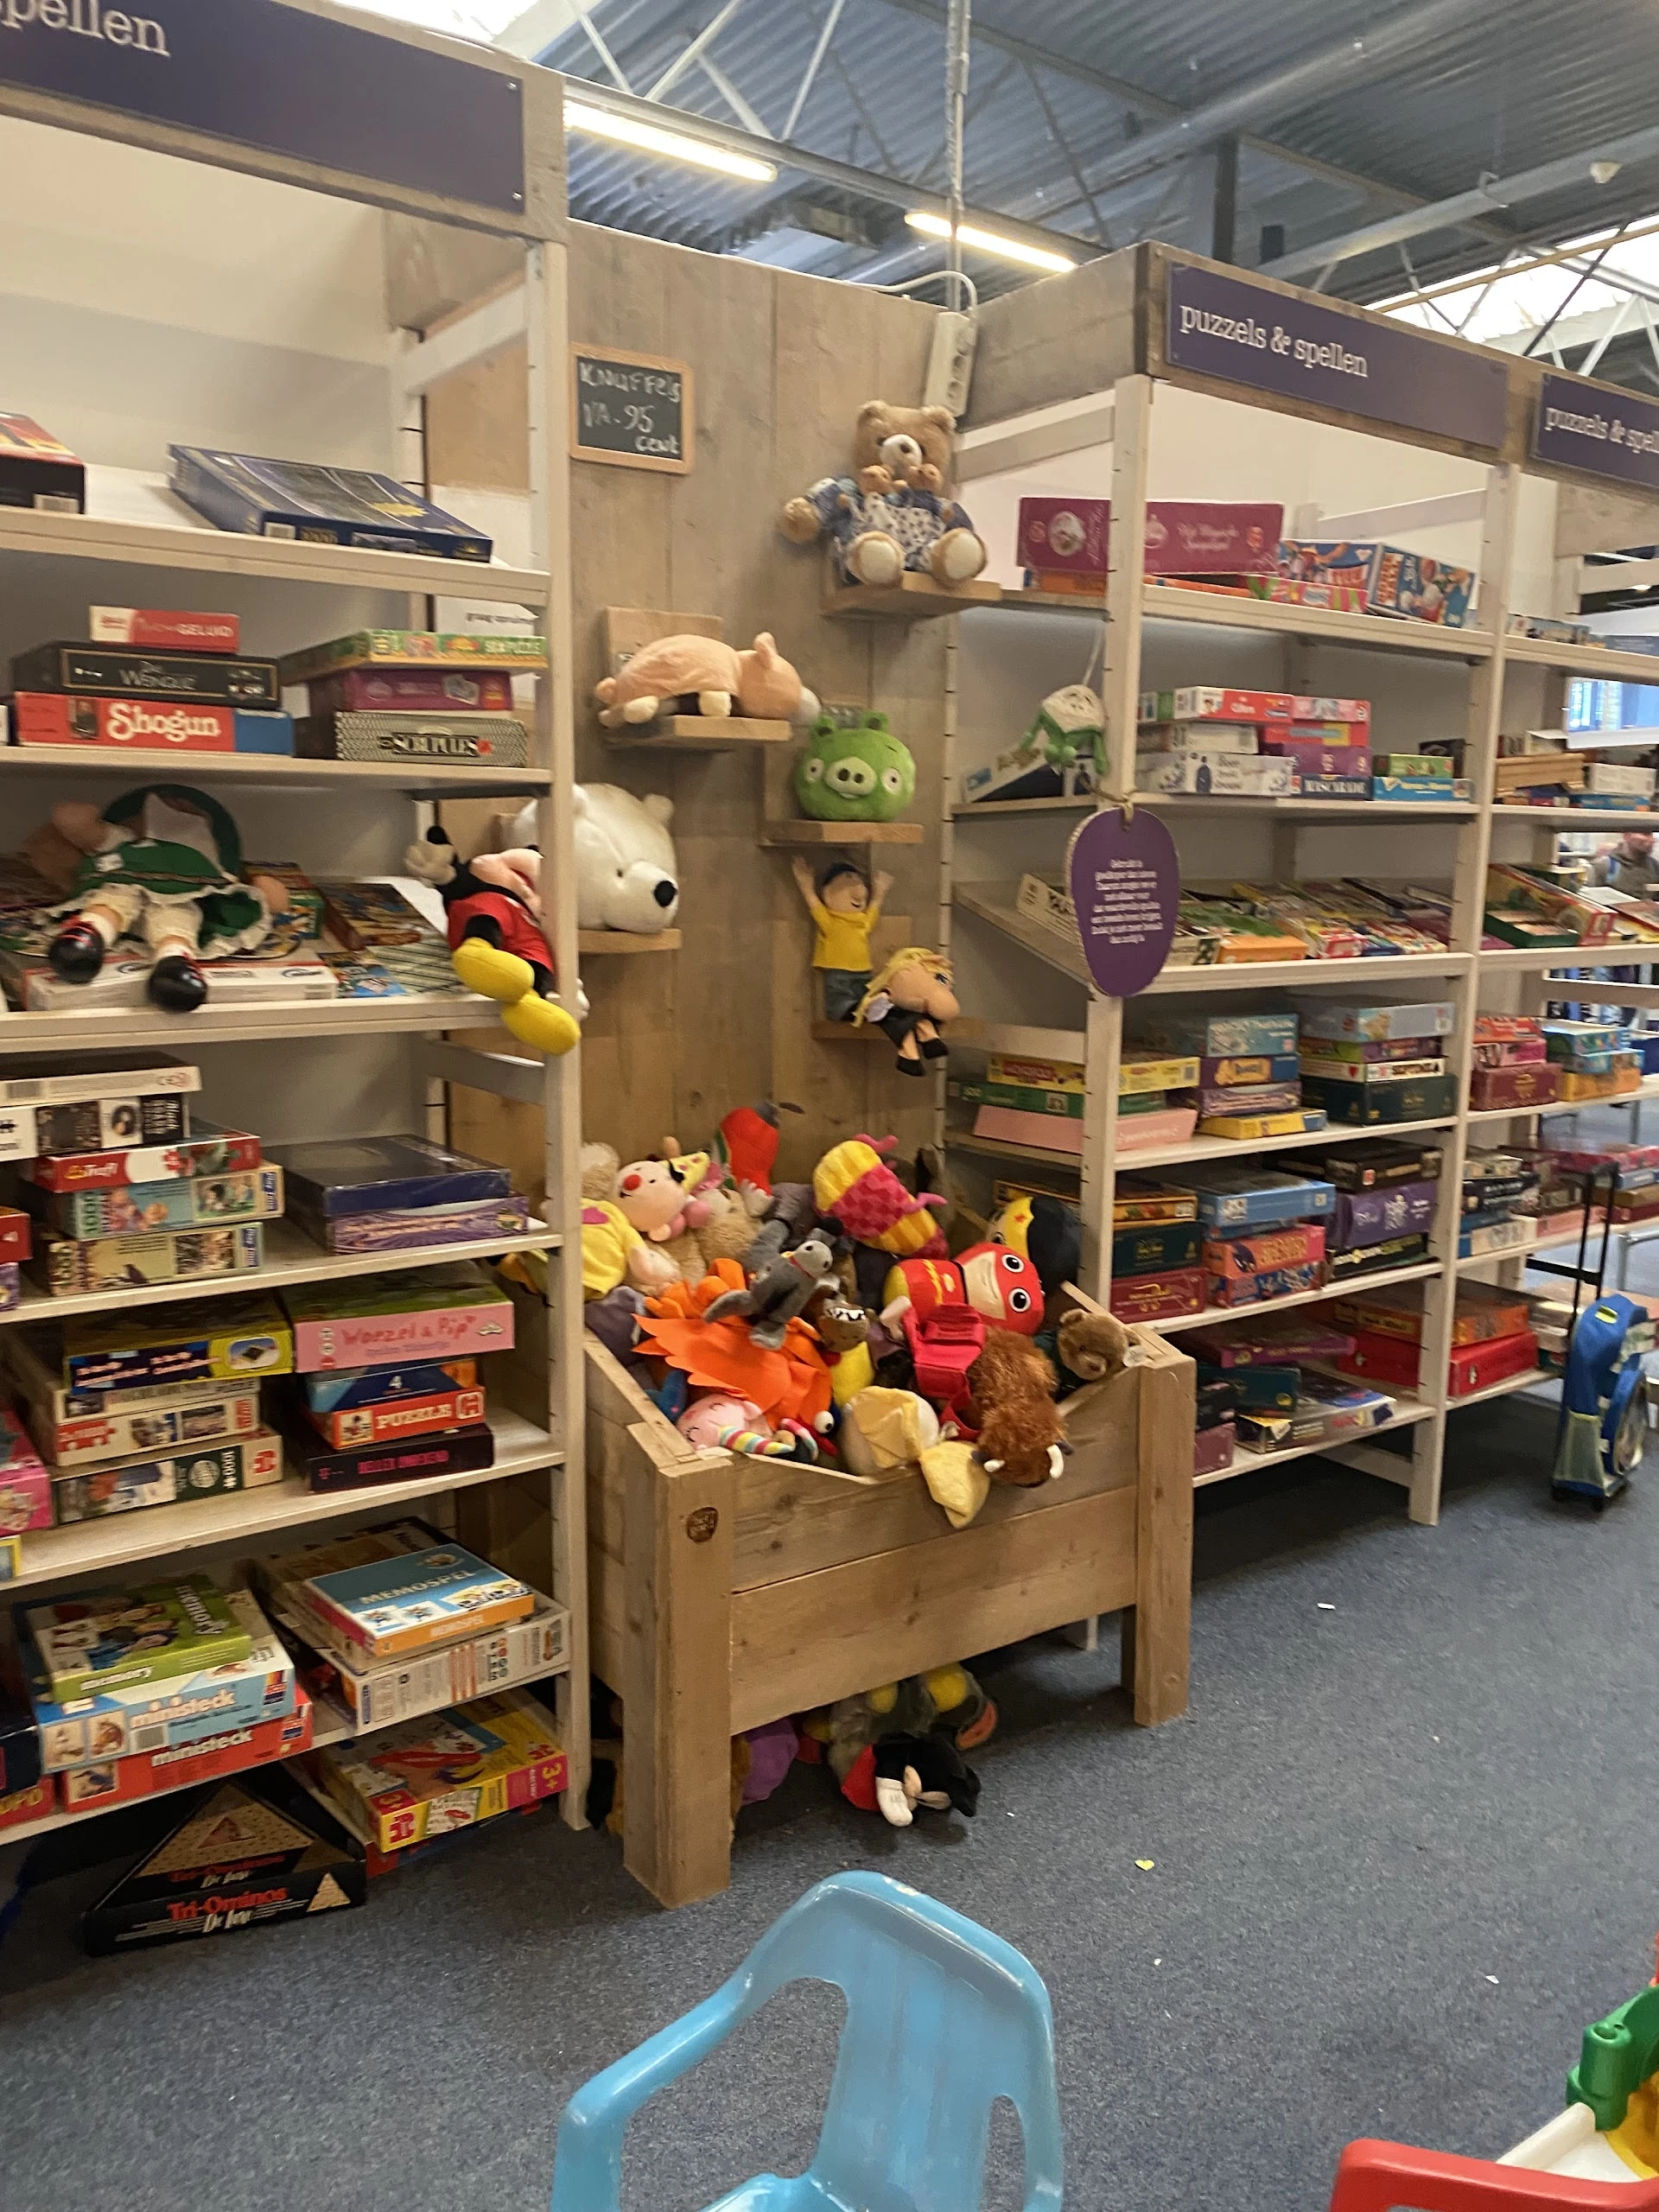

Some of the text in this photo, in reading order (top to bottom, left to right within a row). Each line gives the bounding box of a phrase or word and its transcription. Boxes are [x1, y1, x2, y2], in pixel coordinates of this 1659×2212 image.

[0, 0, 171, 57] pellen
[1179, 305, 1369, 378] puzzels & spellen
[1544, 407, 1609, 439] puzzels
[107, 702, 221, 742] Shogun
[131, 1688, 236, 1728] ministeck
